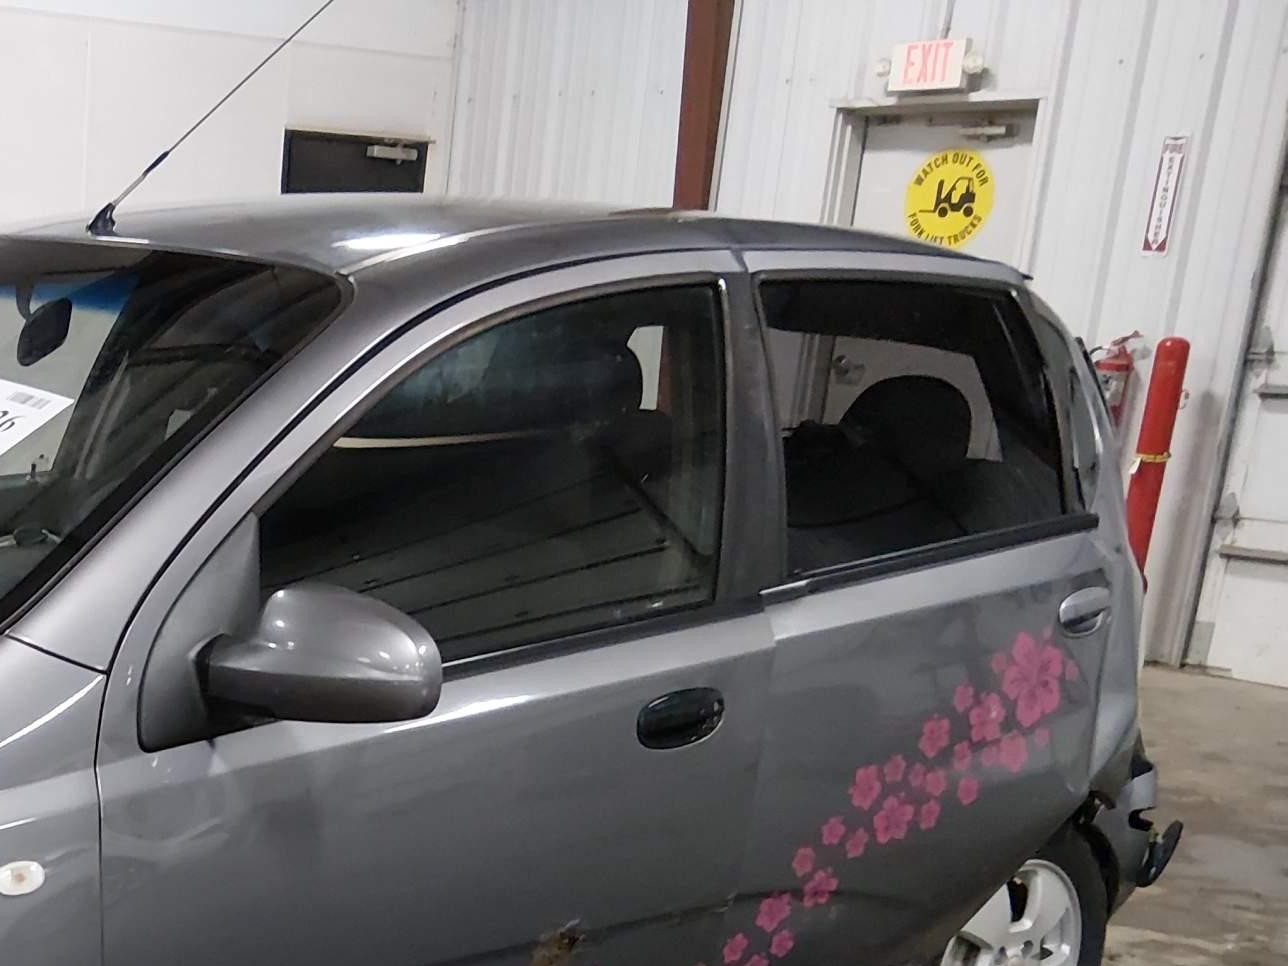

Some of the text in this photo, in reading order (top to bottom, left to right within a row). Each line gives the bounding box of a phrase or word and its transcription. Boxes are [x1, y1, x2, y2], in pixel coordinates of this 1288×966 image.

[903, 41, 954, 84] EXIT
[913, 152, 989, 187] WATCH OUT FOR
[908, 212, 982, 246] FORK LIFT TRUCKS
